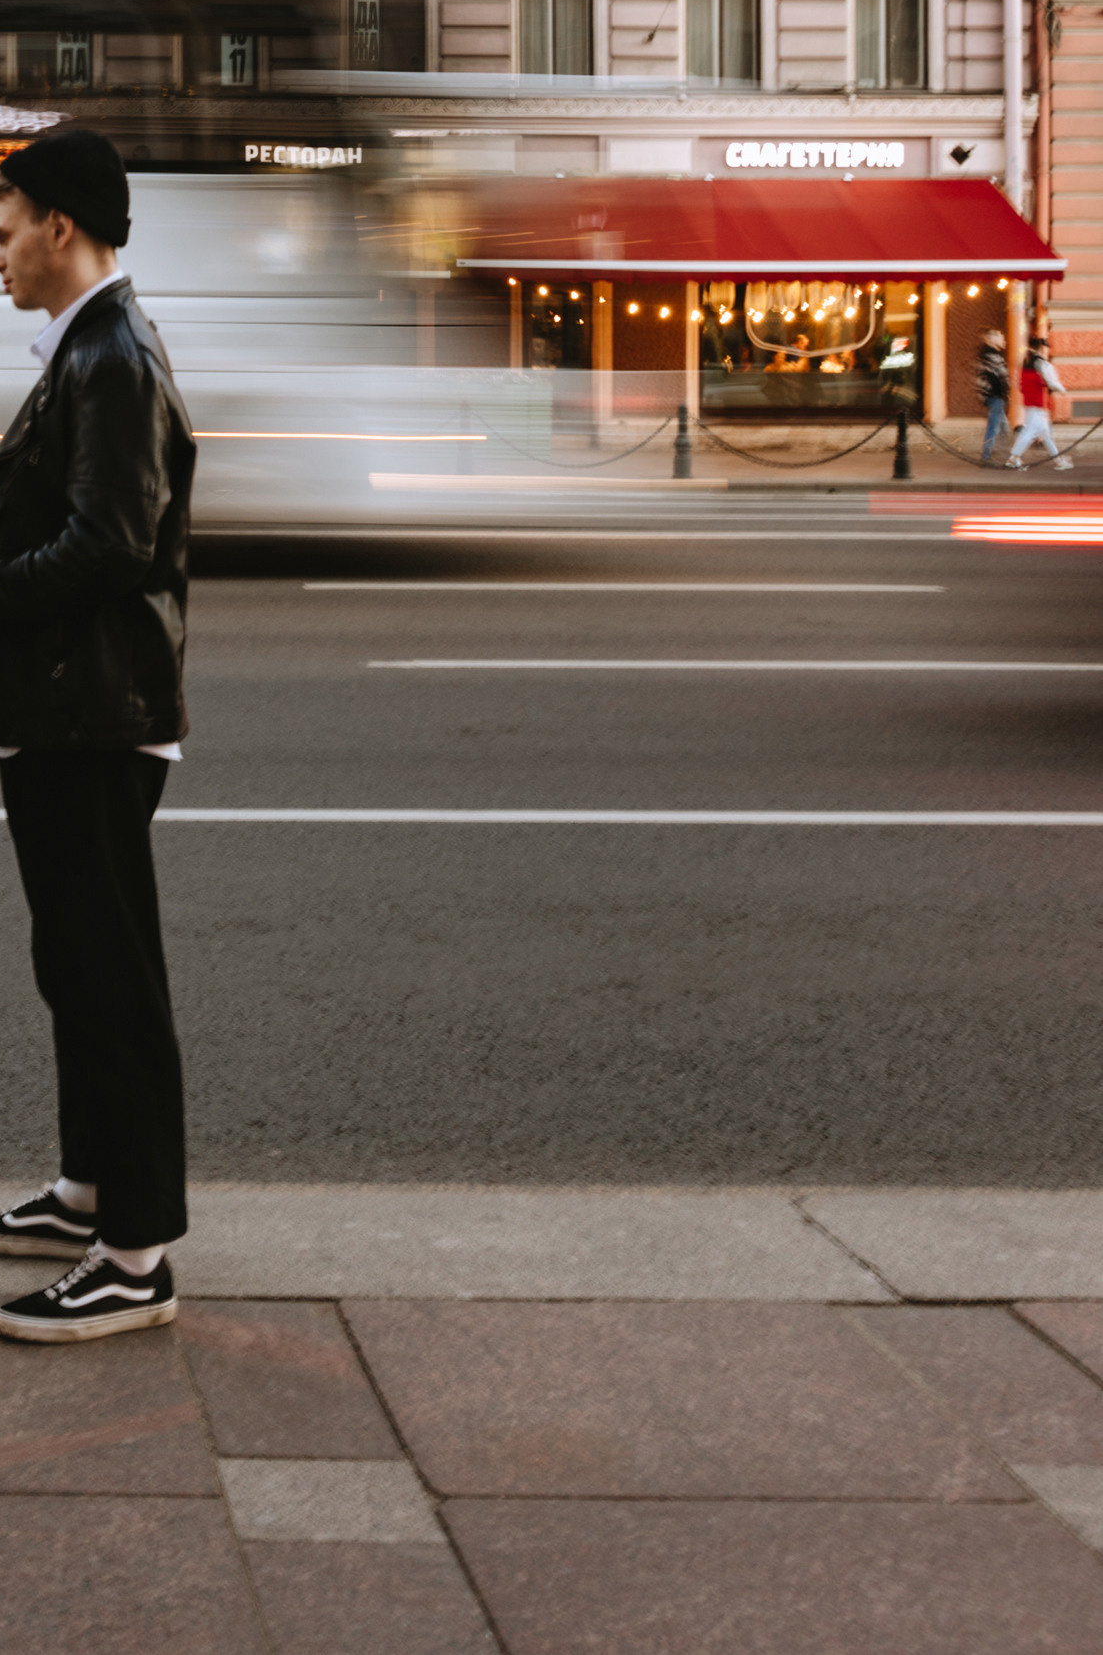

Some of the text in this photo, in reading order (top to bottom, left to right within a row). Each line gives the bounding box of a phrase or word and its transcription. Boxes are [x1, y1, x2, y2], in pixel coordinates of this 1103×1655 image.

[229, 49, 246, 83] 17
[244, 144, 363, 164] РЕСТОРАН
[726, 142, 905, 168] СПАГЕТТЕРИЯ
